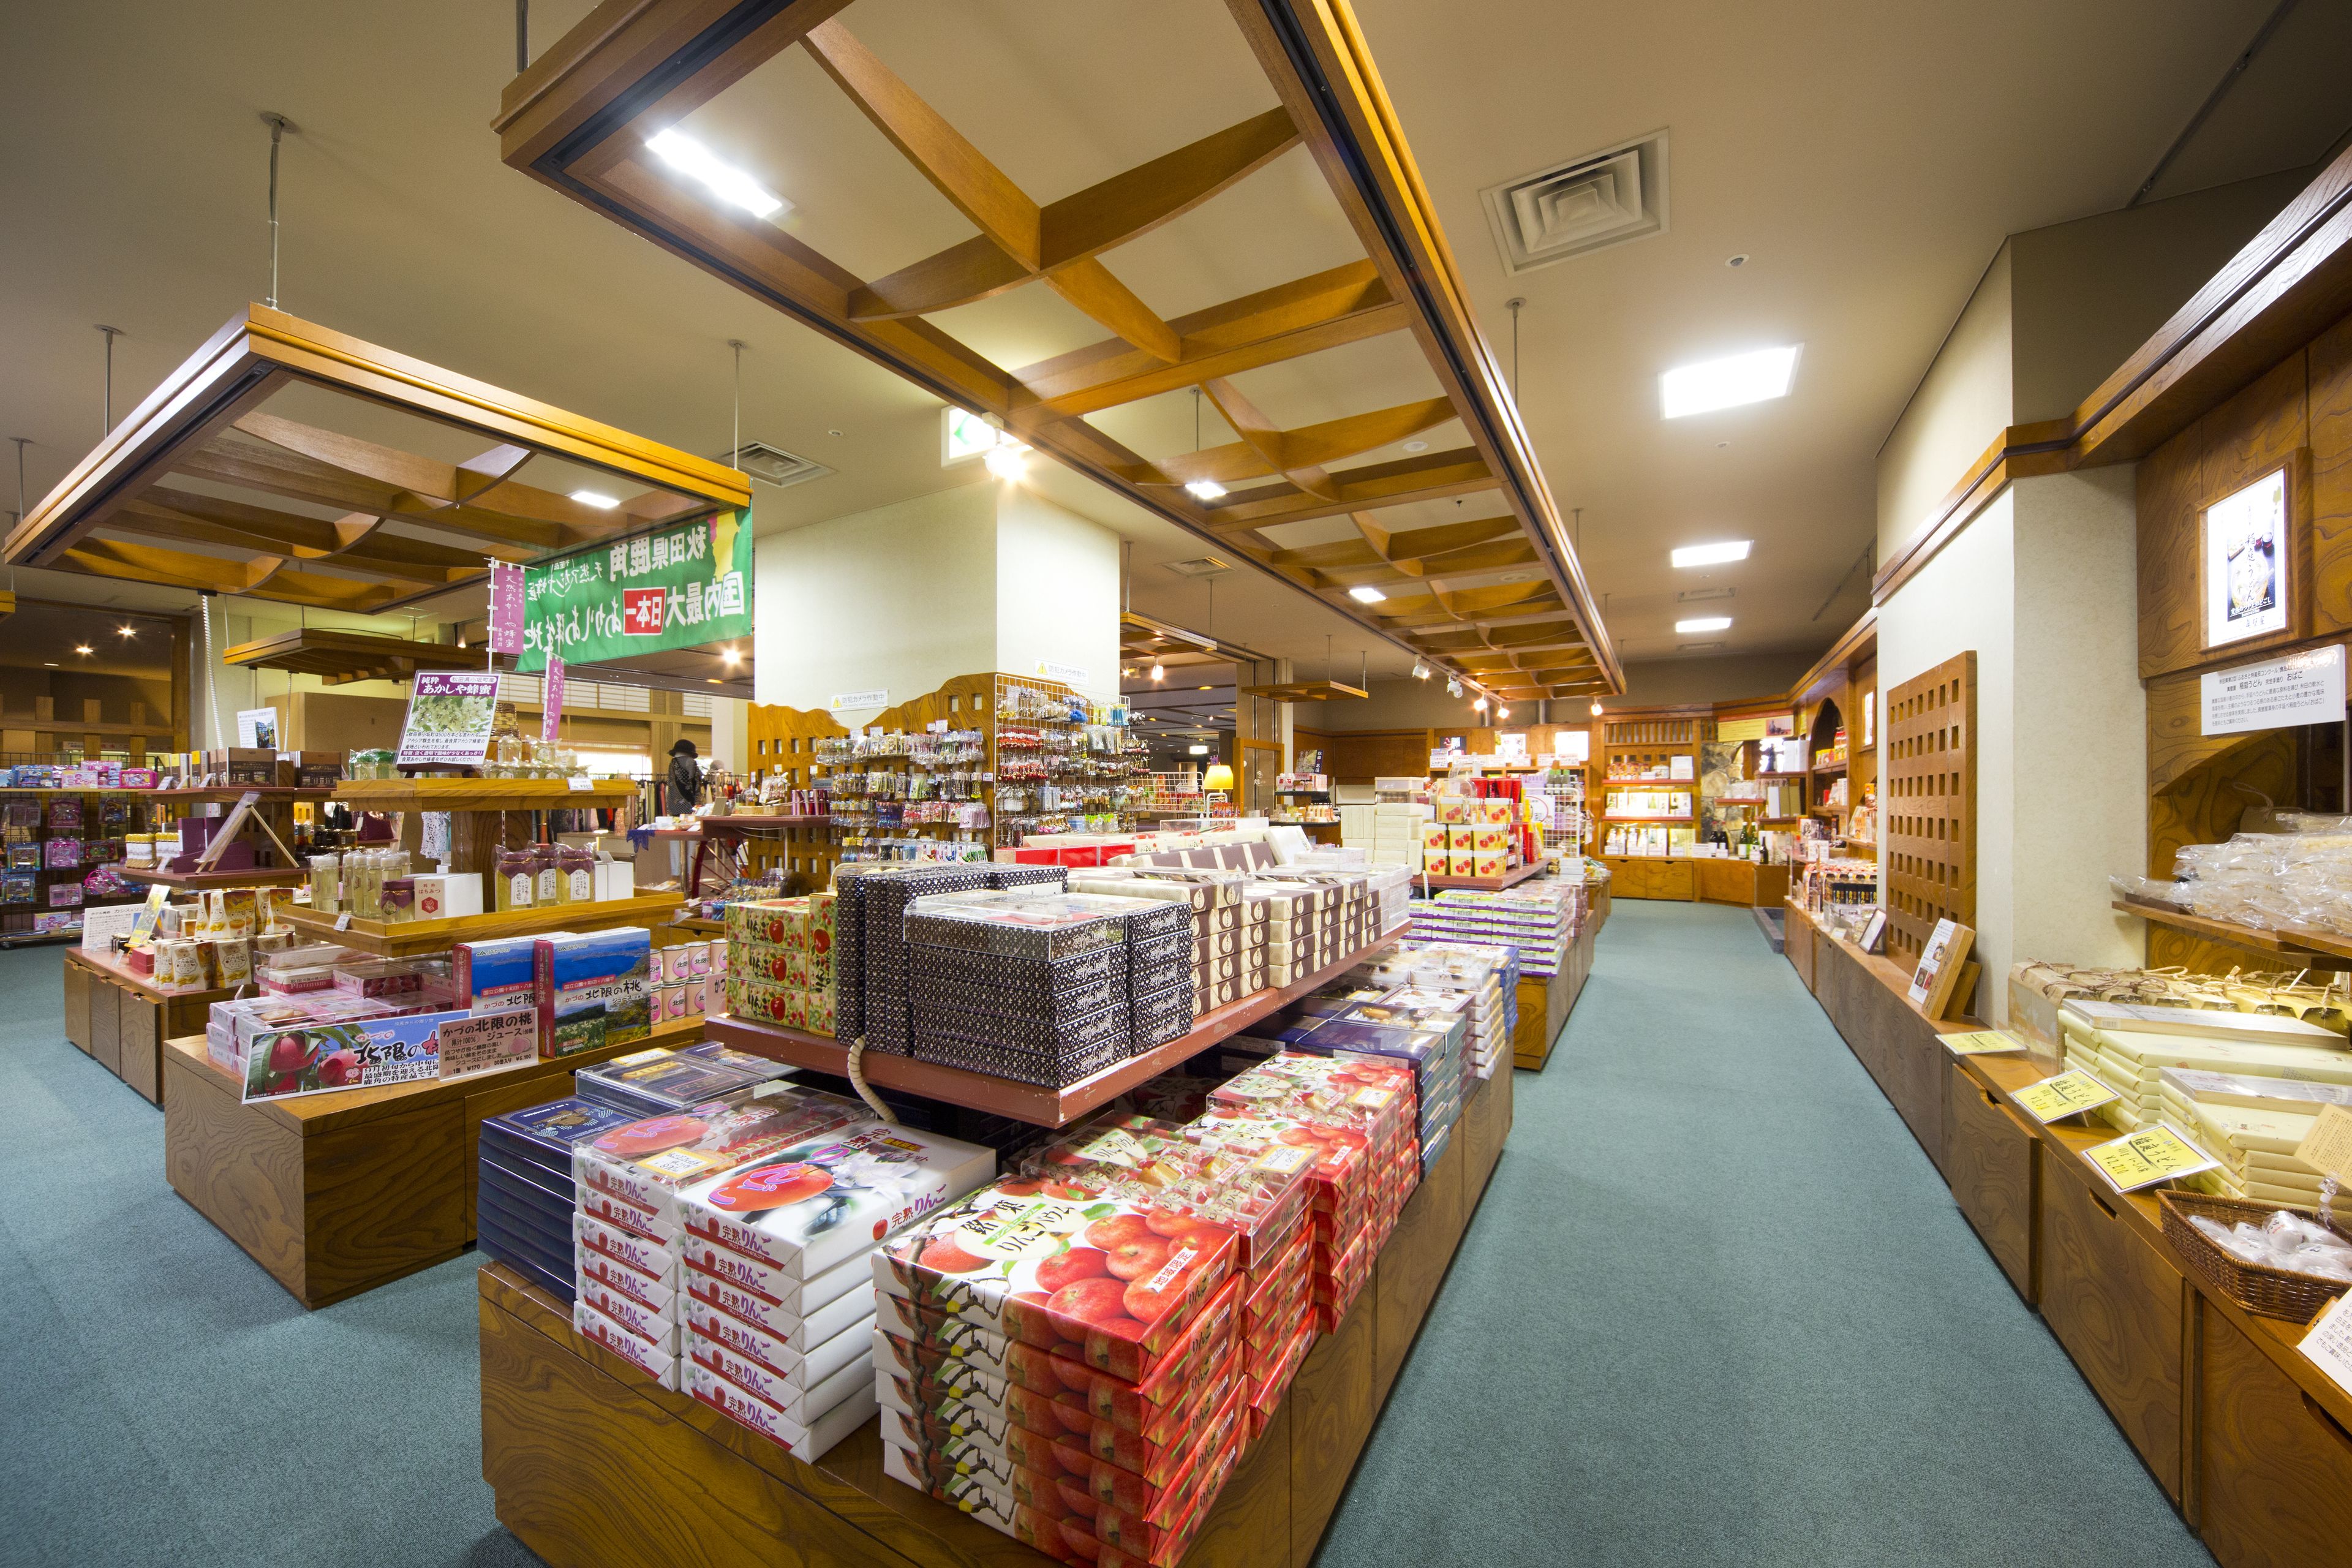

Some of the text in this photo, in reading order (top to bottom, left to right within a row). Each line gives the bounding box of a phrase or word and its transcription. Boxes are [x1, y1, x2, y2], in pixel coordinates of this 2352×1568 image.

[2245, 532, 2255, 602] 稲庭うどん
[505, 575, 517, 647] 天然あかしや蜂蜜
[423, 684, 492, 695] あかしや蜂蜜
[2239, 679, 2263, 690] 稲庭うどん
[2286, 671, 2303, 682] おばこ
[842, 694, 884, 704] 防犯カメラ作動中
[290, 981, 326, 989] Platinum
[565, 979, 643, 1003] かづの 北限の桃
[483, 1000, 504, 1009] かづの
[612, 995, 632, 1005] ジュース
[355, 1031, 395, 1041] かづの
[443, 1012, 532, 1037] かづの北限の桃
[487, 1028, 522, 1041] ジュース
[445, 1048, 497, 1061] 美味しい桃をそのまま
[451, 1036, 477, 1046] 果汁100%
[364, 1059, 439, 1072] 9月初旬から中旬に
[455, 1054, 502, 1066] ジュースにしました
[363, 1072, 438, 1086] 鹿角の特産品です。
[2054, 1079, 2094, 1104] 稲庭うどん
[707, 1143, 851, 1206] りんご
[843, 1128, 891, 1149] 完熟
[2133, 1136, 2181, 1170] 稲庭うどん
[610, 1177, 648, 1205] 完熟りんご
[614, 1206, 654, 1233] 完熟りんご
[891, 1184, 946, 1229] 完熟りんご
[961, 1199, 1026, 1235] 銘菓
[722, 1224, 772, 1256] 完熟りんご
[997, 1206, 1076, 1253] りんごバウム
[609, 1238, 648, 1268] 完熟りんご
[718, 1258, 767, 1290] 完熟りんご
[1152, 1251, 1192, 1286] 地域限定
[611, 1269, 648, 1299] 完熟りんご
[611, 1300, 648, 1332] 完熟りんご
[722, 1290, 771, 1324] 完熟りんご
[609, 1332, 647, 1365] 完熟りんご
[723, 1325, 771, 1360] 完熟りんご
[725, 1359, 772, 1396] 完熟りんご
[728, 1396, 777, 1433] 完熟りんご
